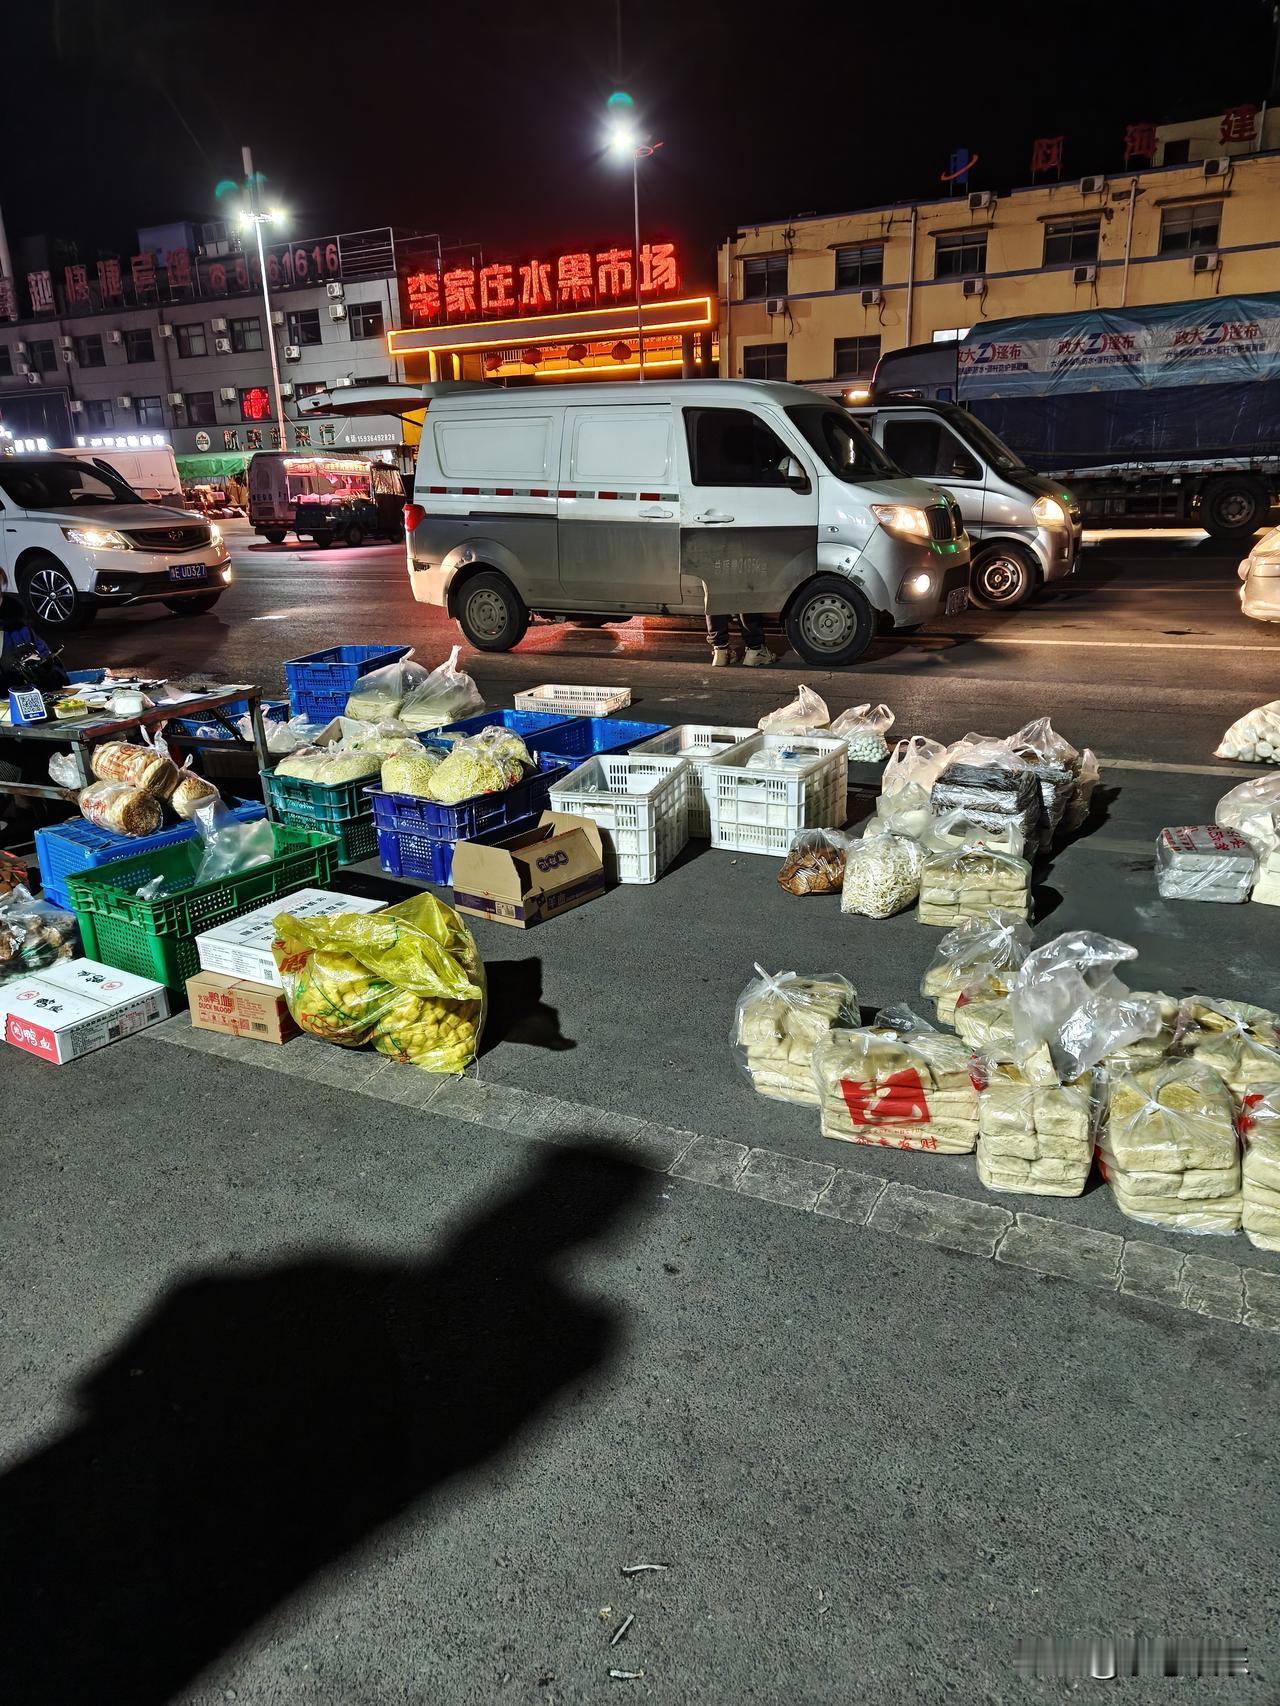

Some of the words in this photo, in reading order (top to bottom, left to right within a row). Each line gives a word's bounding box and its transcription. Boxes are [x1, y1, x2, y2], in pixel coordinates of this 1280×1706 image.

[407, 243, 679, 318] 李家庄水果市场
[198, 1002, 212, 1010] DUCK
[213, 1005, 232, 1014] BLOOD
